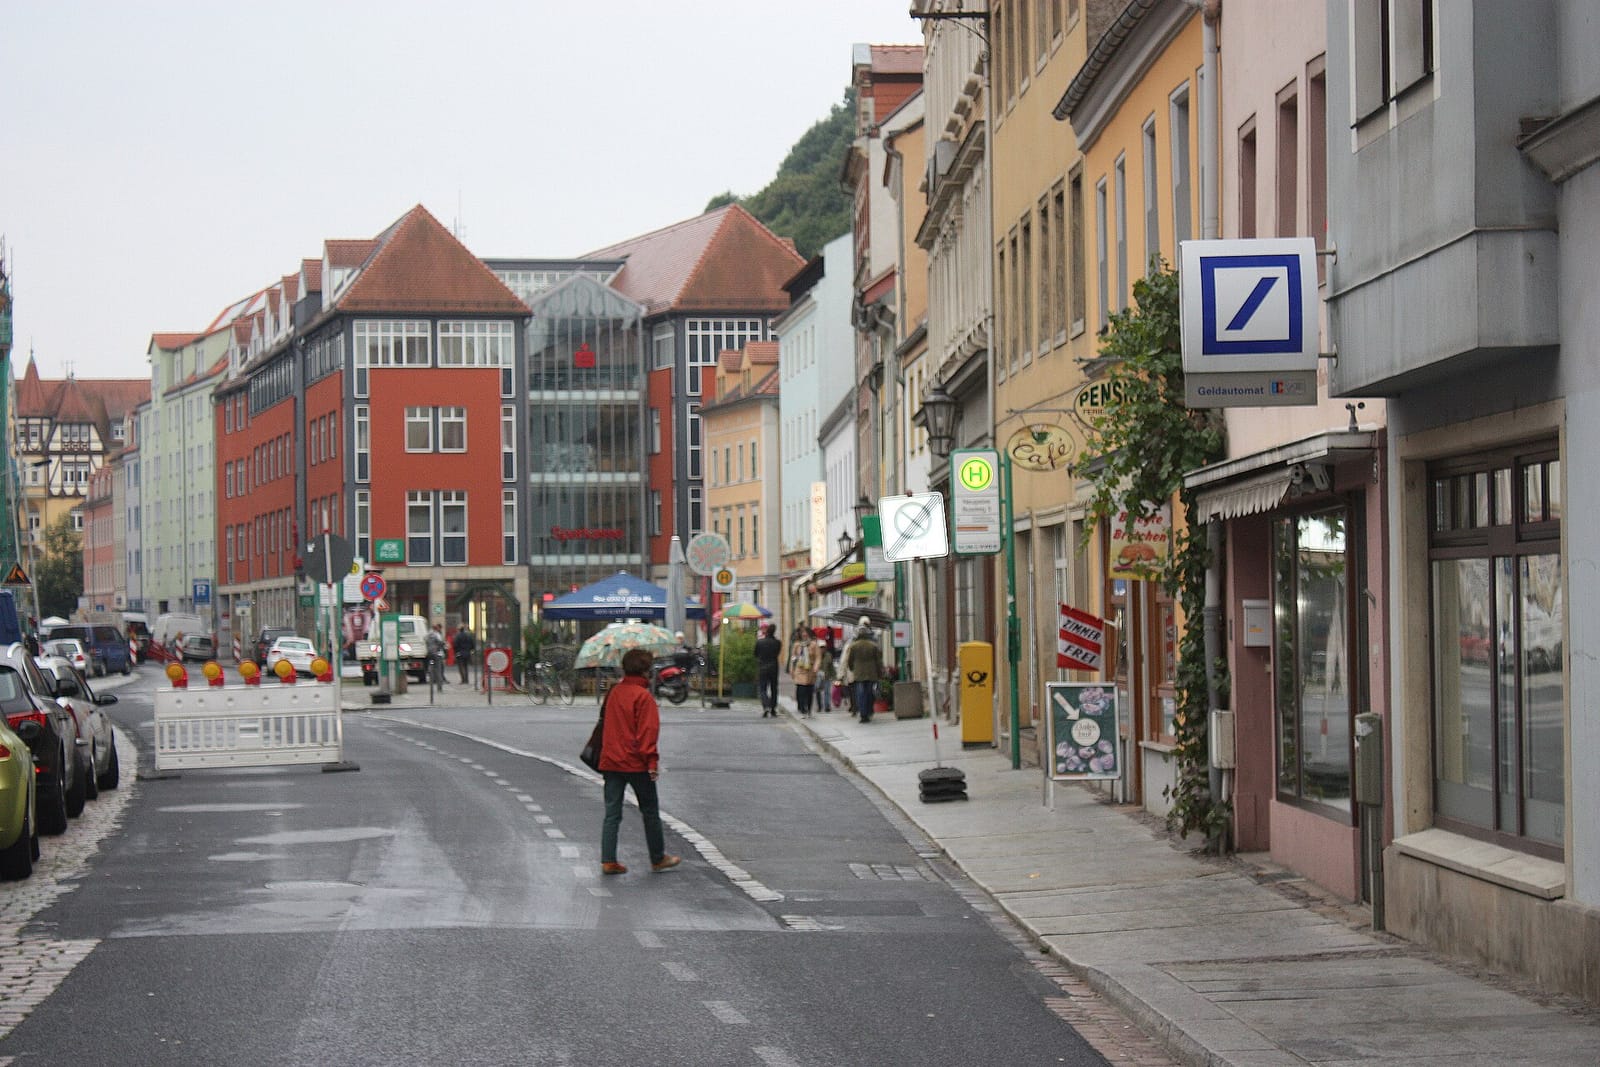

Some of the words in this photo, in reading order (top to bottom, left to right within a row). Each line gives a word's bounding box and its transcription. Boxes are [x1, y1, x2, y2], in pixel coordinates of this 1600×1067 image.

[1198, 386, 1264, 396] Geldautomat
[1012, 437, 1072, 470] Café
[969, 466, 983, 481] H
[1063, 619, 1102, 641] ZIMMER
[1064, 644, 1097, 664] FREI
